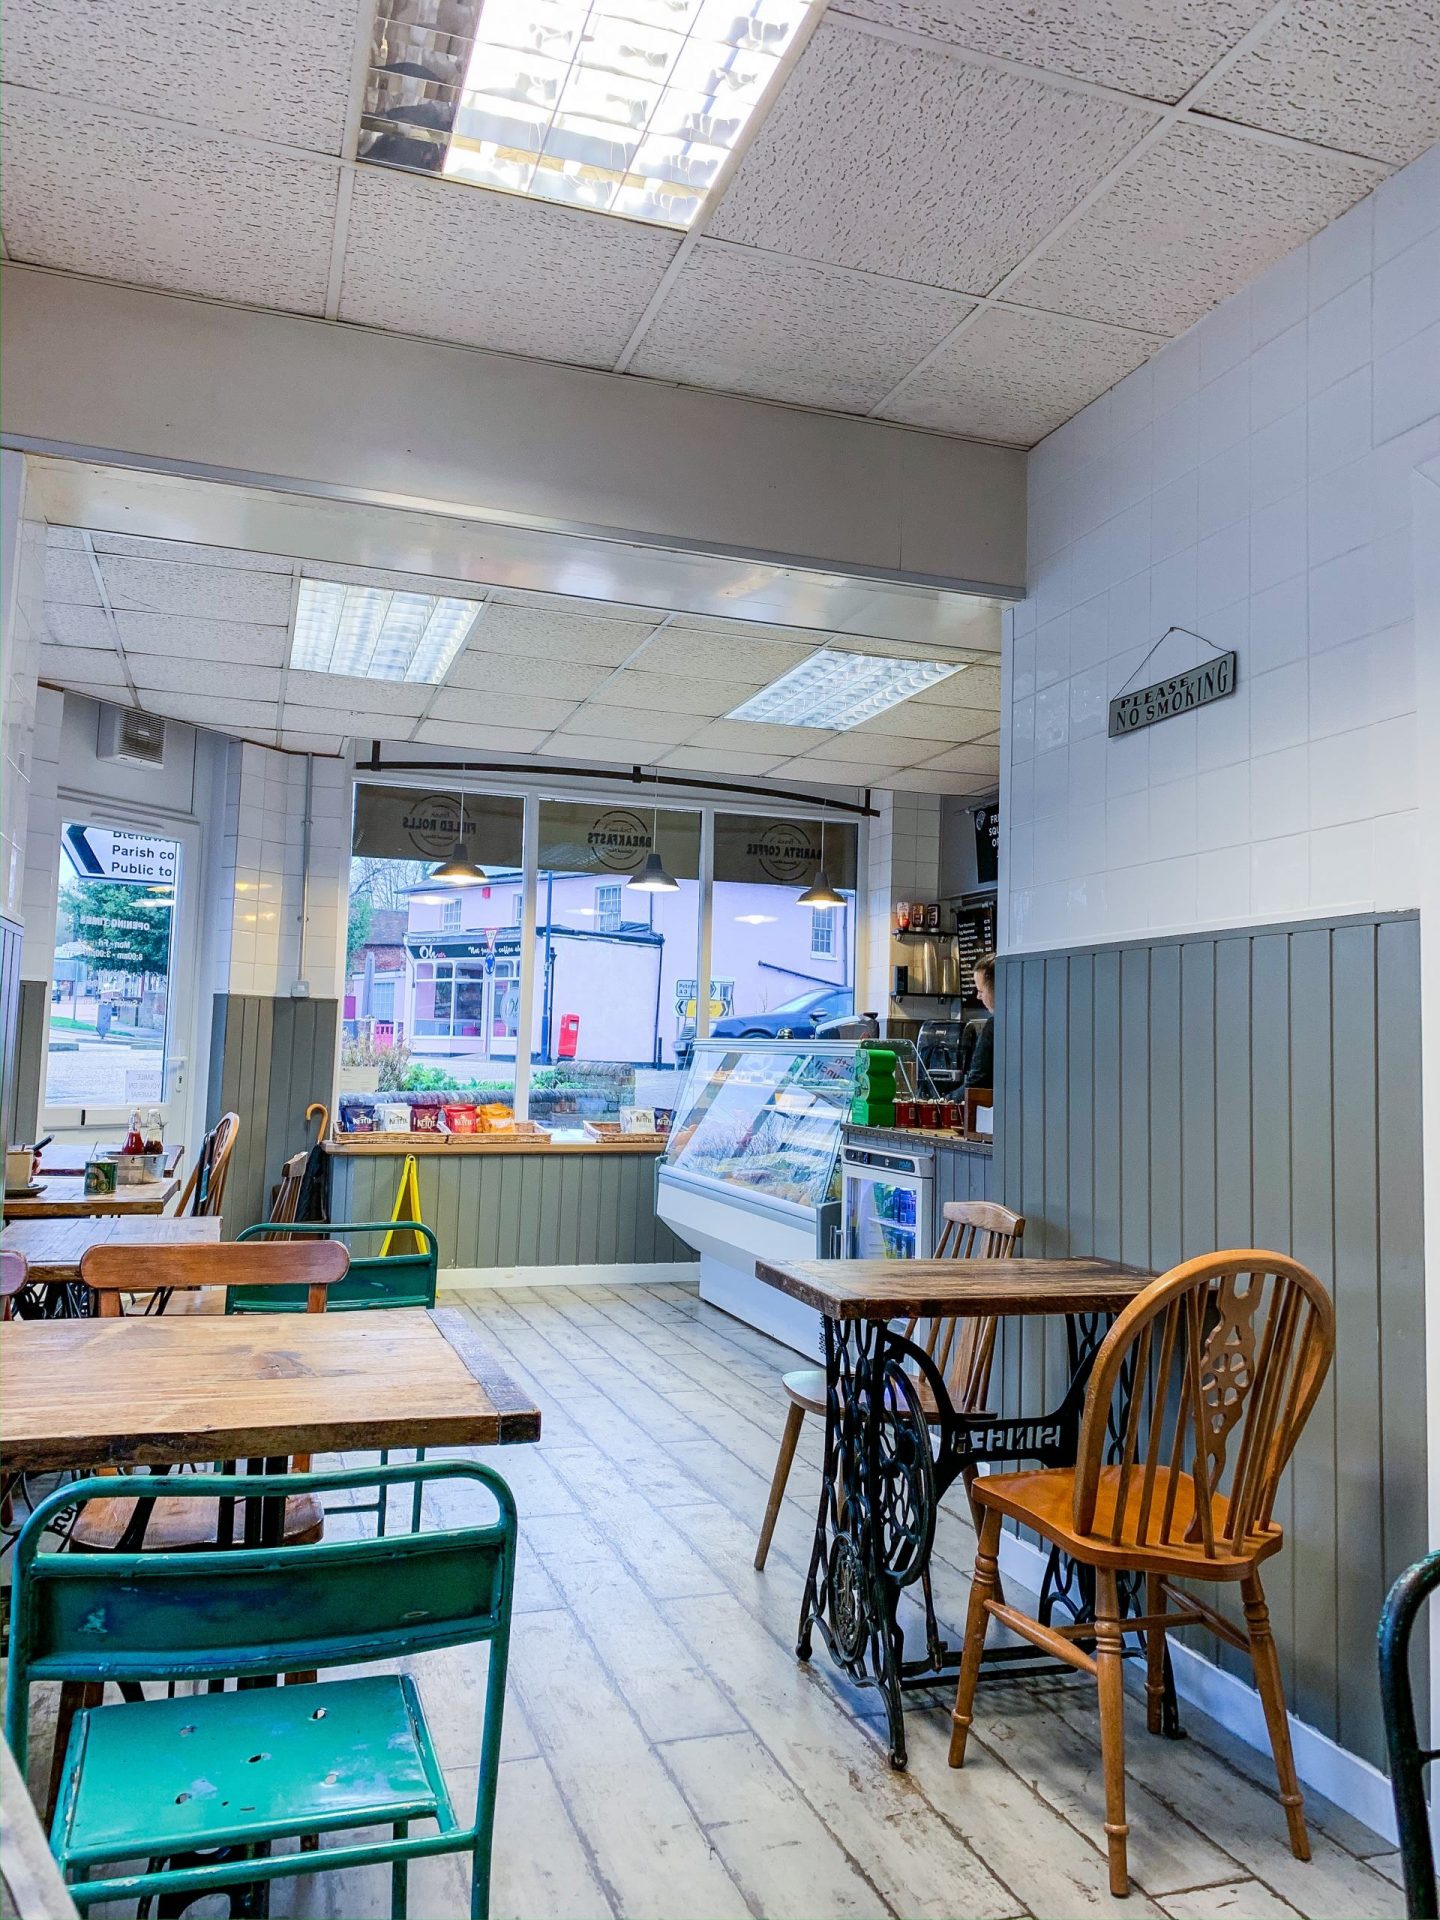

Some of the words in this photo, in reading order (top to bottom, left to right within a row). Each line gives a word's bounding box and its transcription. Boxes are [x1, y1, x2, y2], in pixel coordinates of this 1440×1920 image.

[1116, 708, 1140, 731] NO
[1145, 660, 1229, 721] SMOKING
[1120, 676, 1189, 709] PLEASE
[112, 844, 155, 858] Parish
[159, 851, 175, 860] co
[111, 861, 154, 875] Public
[159, 865, 172, 877] to
